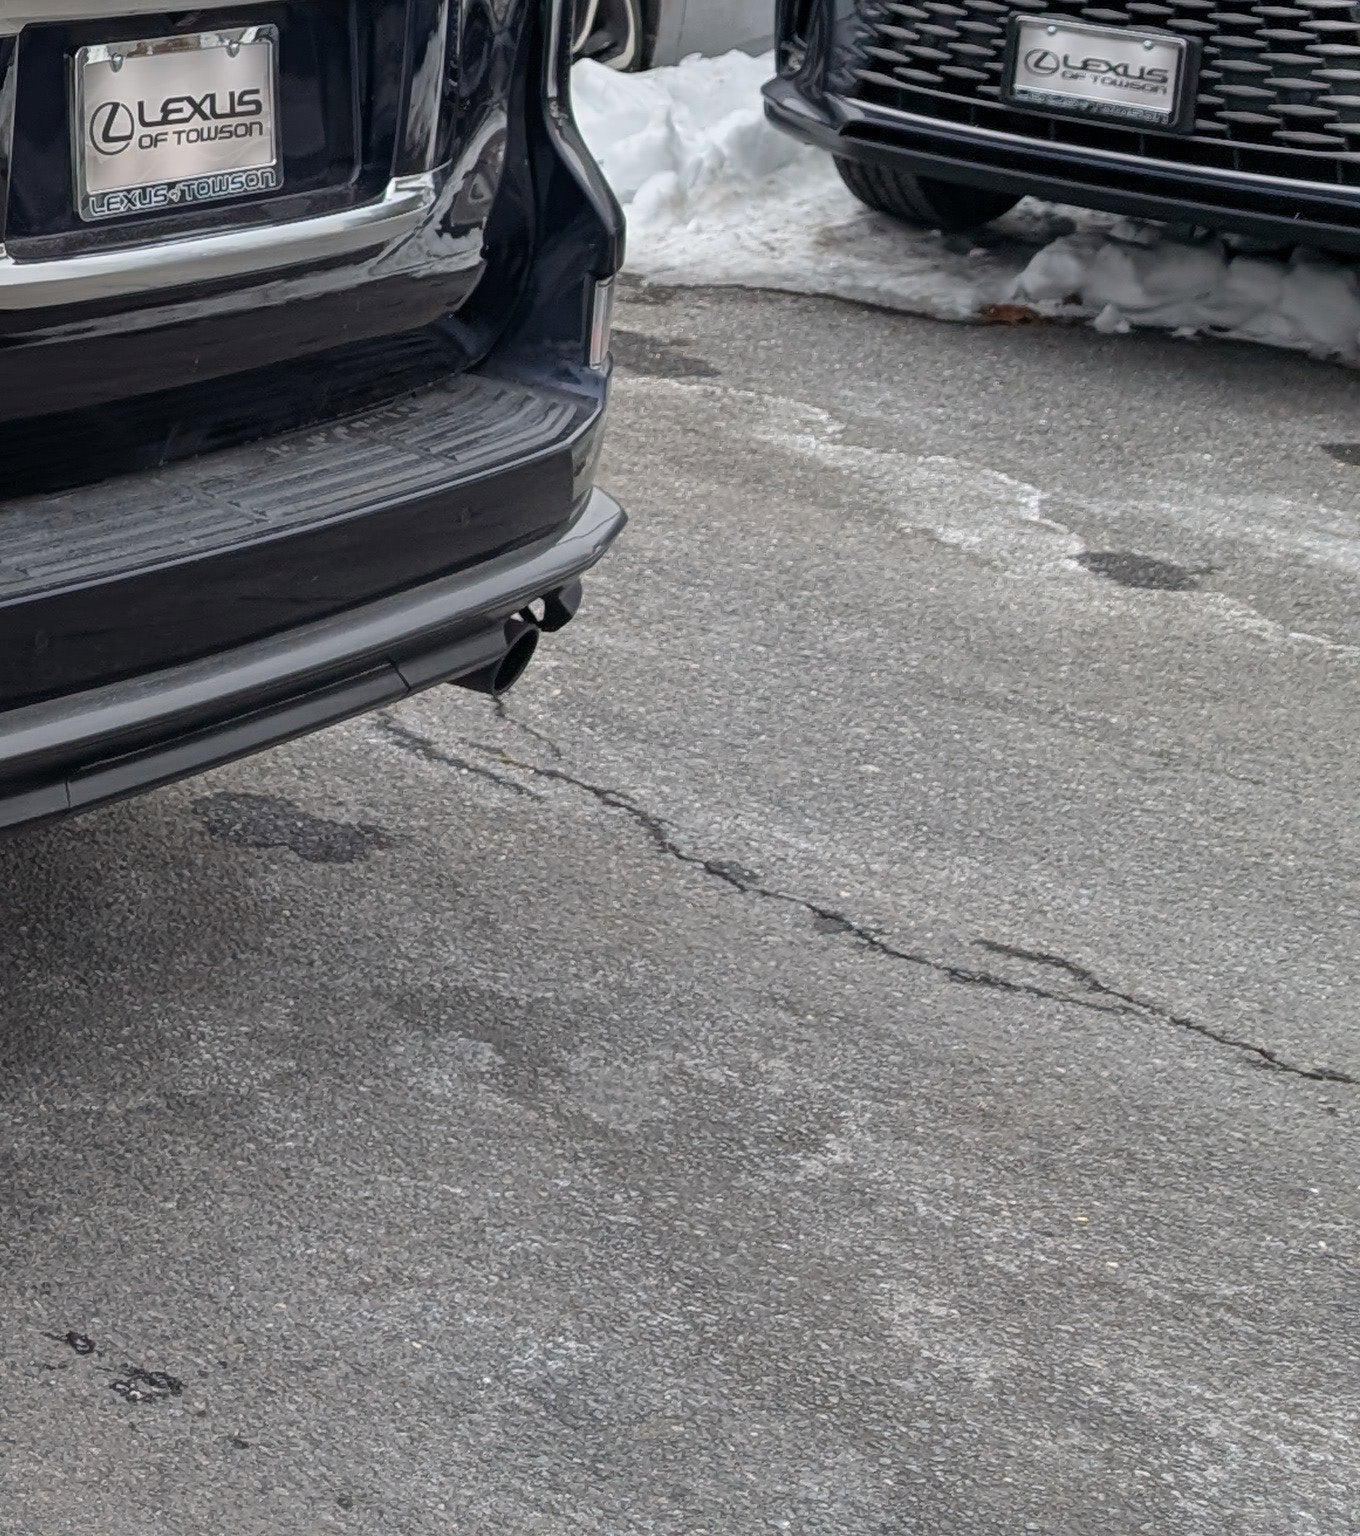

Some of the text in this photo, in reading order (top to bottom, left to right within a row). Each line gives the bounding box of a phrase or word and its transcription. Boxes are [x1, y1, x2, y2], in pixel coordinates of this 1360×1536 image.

[1061, 69, 1168, 96] OF TOWSON
[1062, 52, 1170, 84] LEXUS
[137, 88, 263, 128] LEXUS
[137, 120, 264, 150] OF TOWSON
[88, 184, 169, 216] LEXUS
[180, 167, 277, 201] TOWSON
